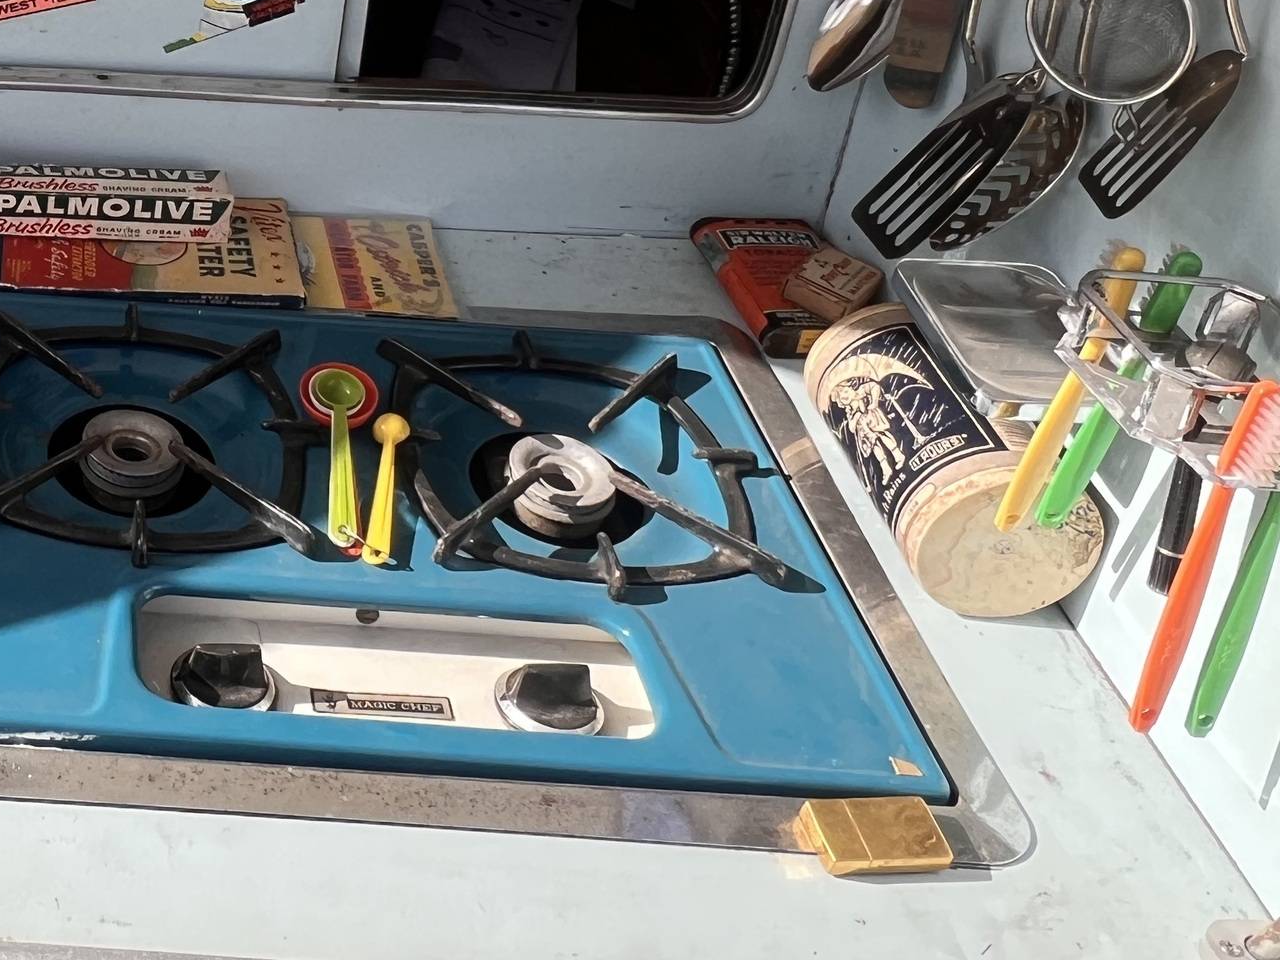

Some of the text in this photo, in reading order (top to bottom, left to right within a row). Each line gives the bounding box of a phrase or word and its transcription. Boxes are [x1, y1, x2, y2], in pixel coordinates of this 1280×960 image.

[102, 185, 146, 193] SHAVING
[96, 226, 141, 234] SHAVING
[229, 214, 257, 278] SAFETY
[730, 235, 815, 249] RALEIGH
[369, 275, 386, 298] AND
[883, 472, 906, 504] Rains
[351, 700, 442, 713] MAGIC CHEF
